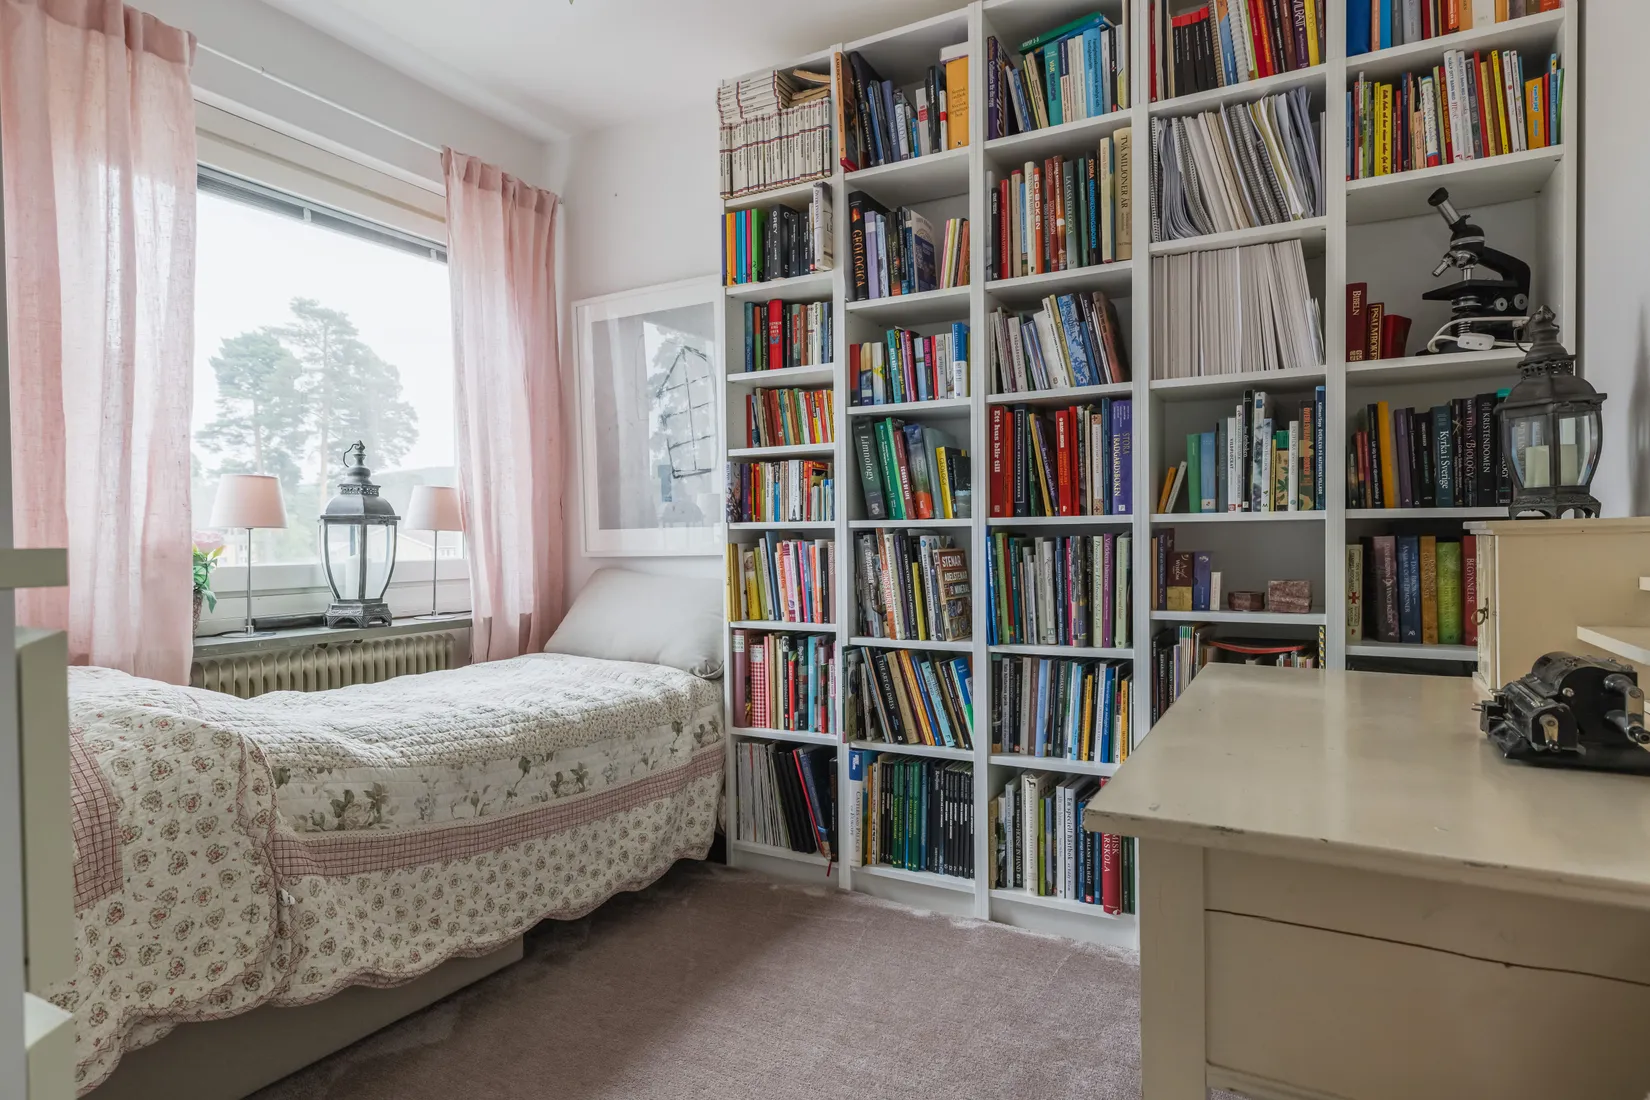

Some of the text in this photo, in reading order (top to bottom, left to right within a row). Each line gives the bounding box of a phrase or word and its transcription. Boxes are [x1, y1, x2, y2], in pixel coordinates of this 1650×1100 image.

[895, 106, 905, 142] CANADA
[1120, 135, 1128, 151] TVÅ
[1121, 197, 1129, 208] ÅR
[852, 230, 864, 287] GEOLOGICA
[1352, 290, 1361, 316] BIBELN
[1122, 432, 1130, 454] STORA
[1438, 430, 1449, 454] Kyrka
[1482, 412, 1491, 473] KRISTENDOMEN
[861, 436, 874, 481] Limnology
[1113, 433, 1122, 497] TRÄDGÅRDSBOKEN
[1465, 440, 1476, 478] BIOLOGY
[900, 466, 909, 484] ECHOES
[939, 458, 947, 486] GEOLOGY
[1439, 460, 1450, 489] Sverige
[941, 555, 962, 568] STENAR
[882, 570, 892, 612] DINOSAURIER
[1466, 558, 1474, 604] BEGYNNELSE
[878, 660, 886, 671] THE
[880, 672, 888, 682] ART
[886, 692, 895, 710] DRESS
[1067, 798, 1073, 806] En
